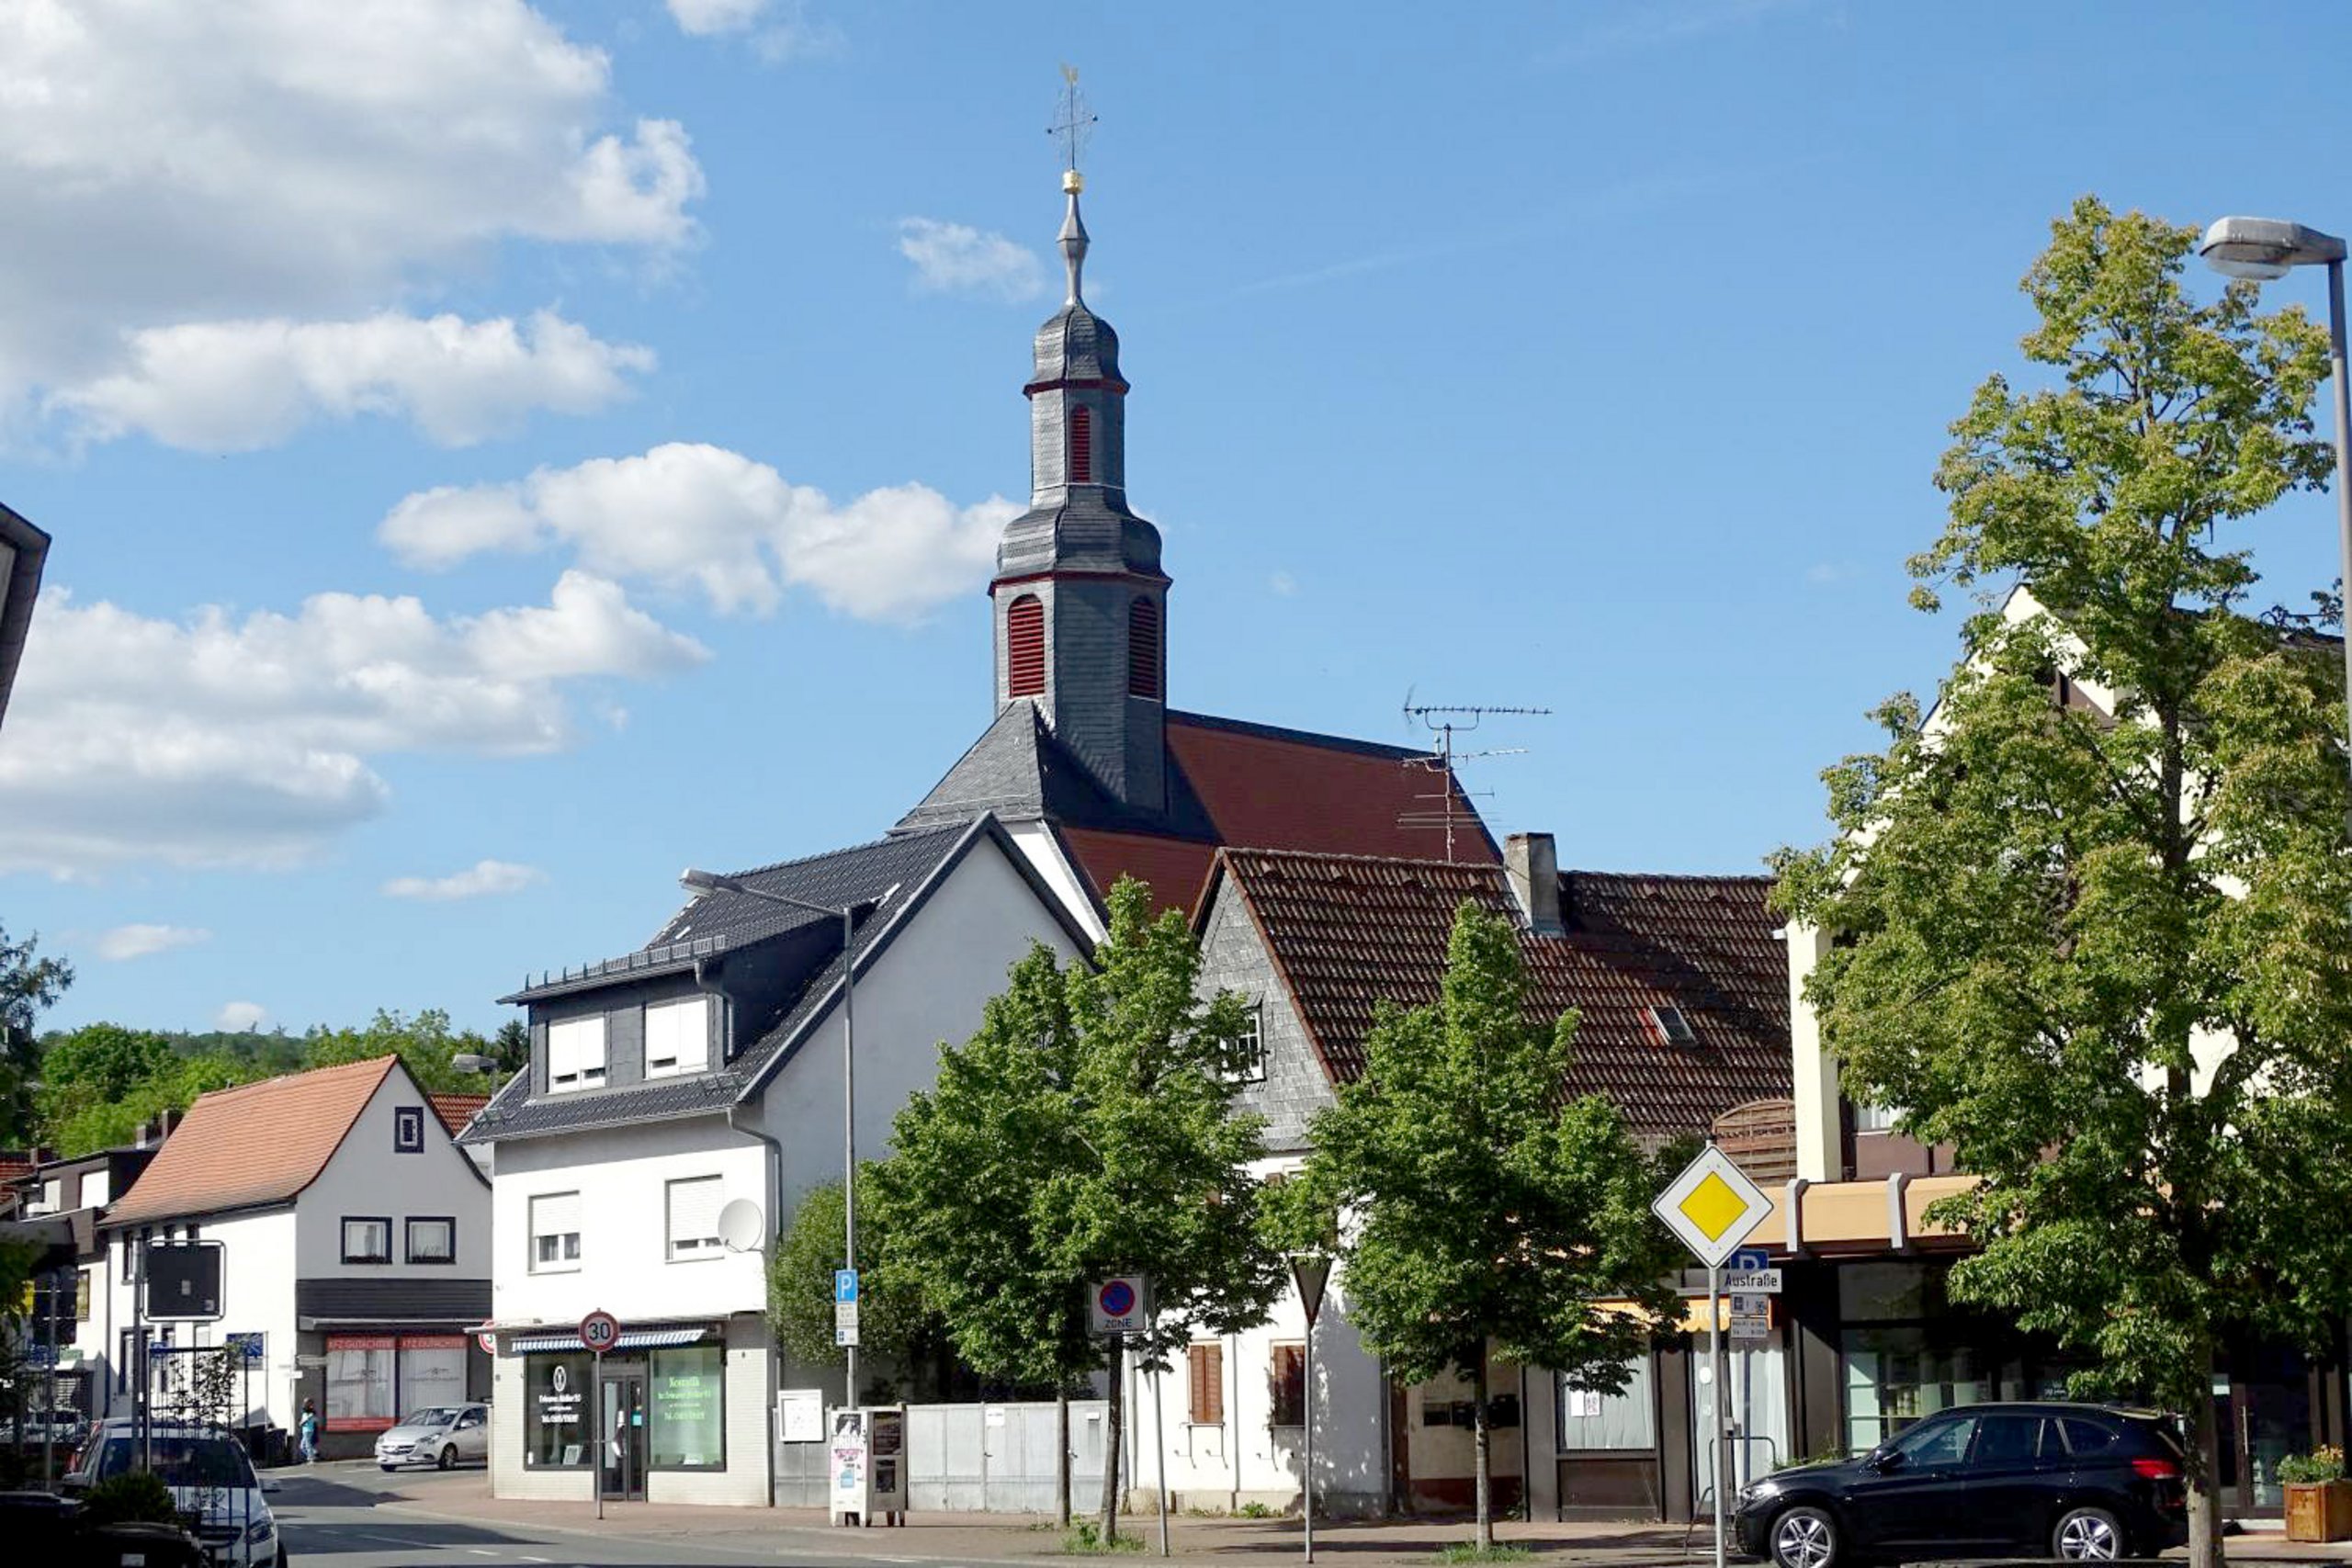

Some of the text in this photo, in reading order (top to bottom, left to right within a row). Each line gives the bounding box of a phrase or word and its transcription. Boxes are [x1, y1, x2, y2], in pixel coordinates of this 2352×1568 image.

[842, 1275, 853, 1299] P
[1725, 1273, 1778, 1287] Austraße
[1104, 1317, 1132, 1328] ZONE
[587, 1322, 611, 1340] 30
